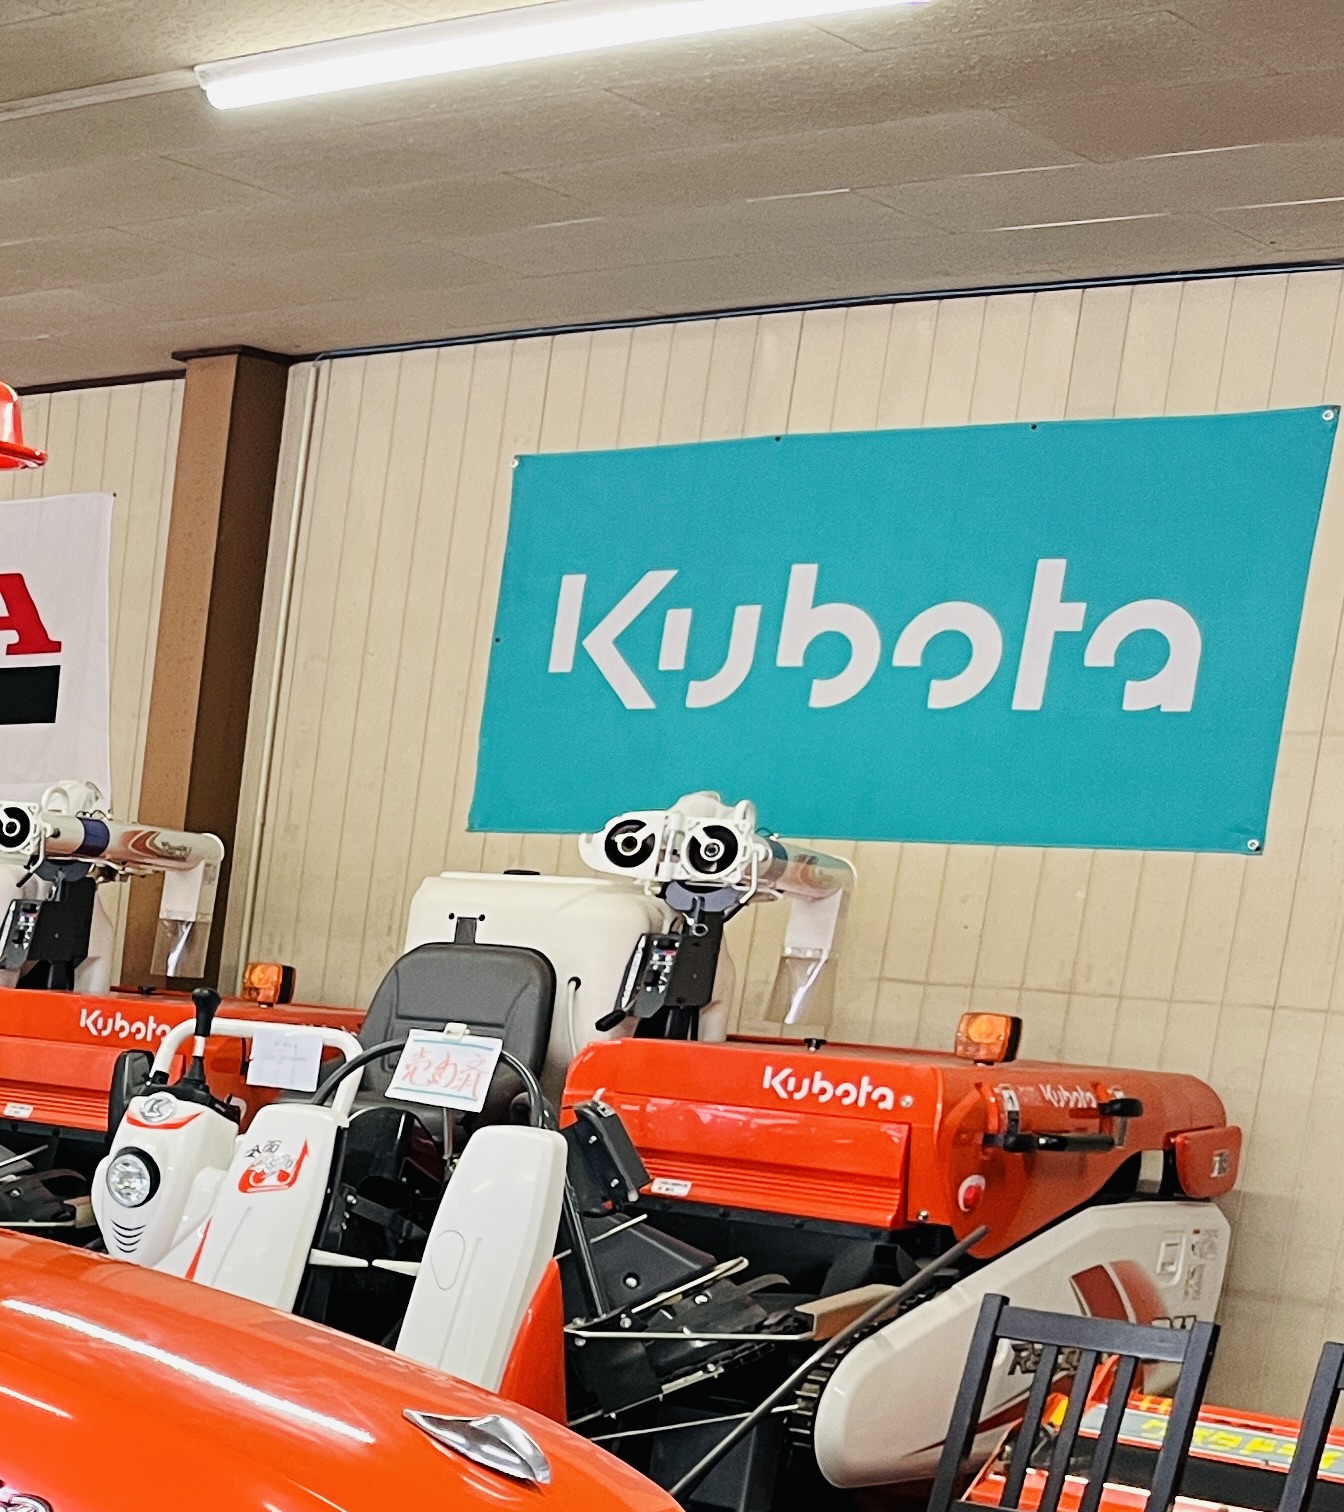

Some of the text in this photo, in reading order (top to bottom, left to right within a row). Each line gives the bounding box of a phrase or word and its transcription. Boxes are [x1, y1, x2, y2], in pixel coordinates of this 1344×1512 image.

[548, 558, 1203, 713] Kubota
[79, 1008, 172, 1042] Kubota
[763, 1066, 894, 1111] Kubota
[1038, 1083, 1098, 1108] Kubota
